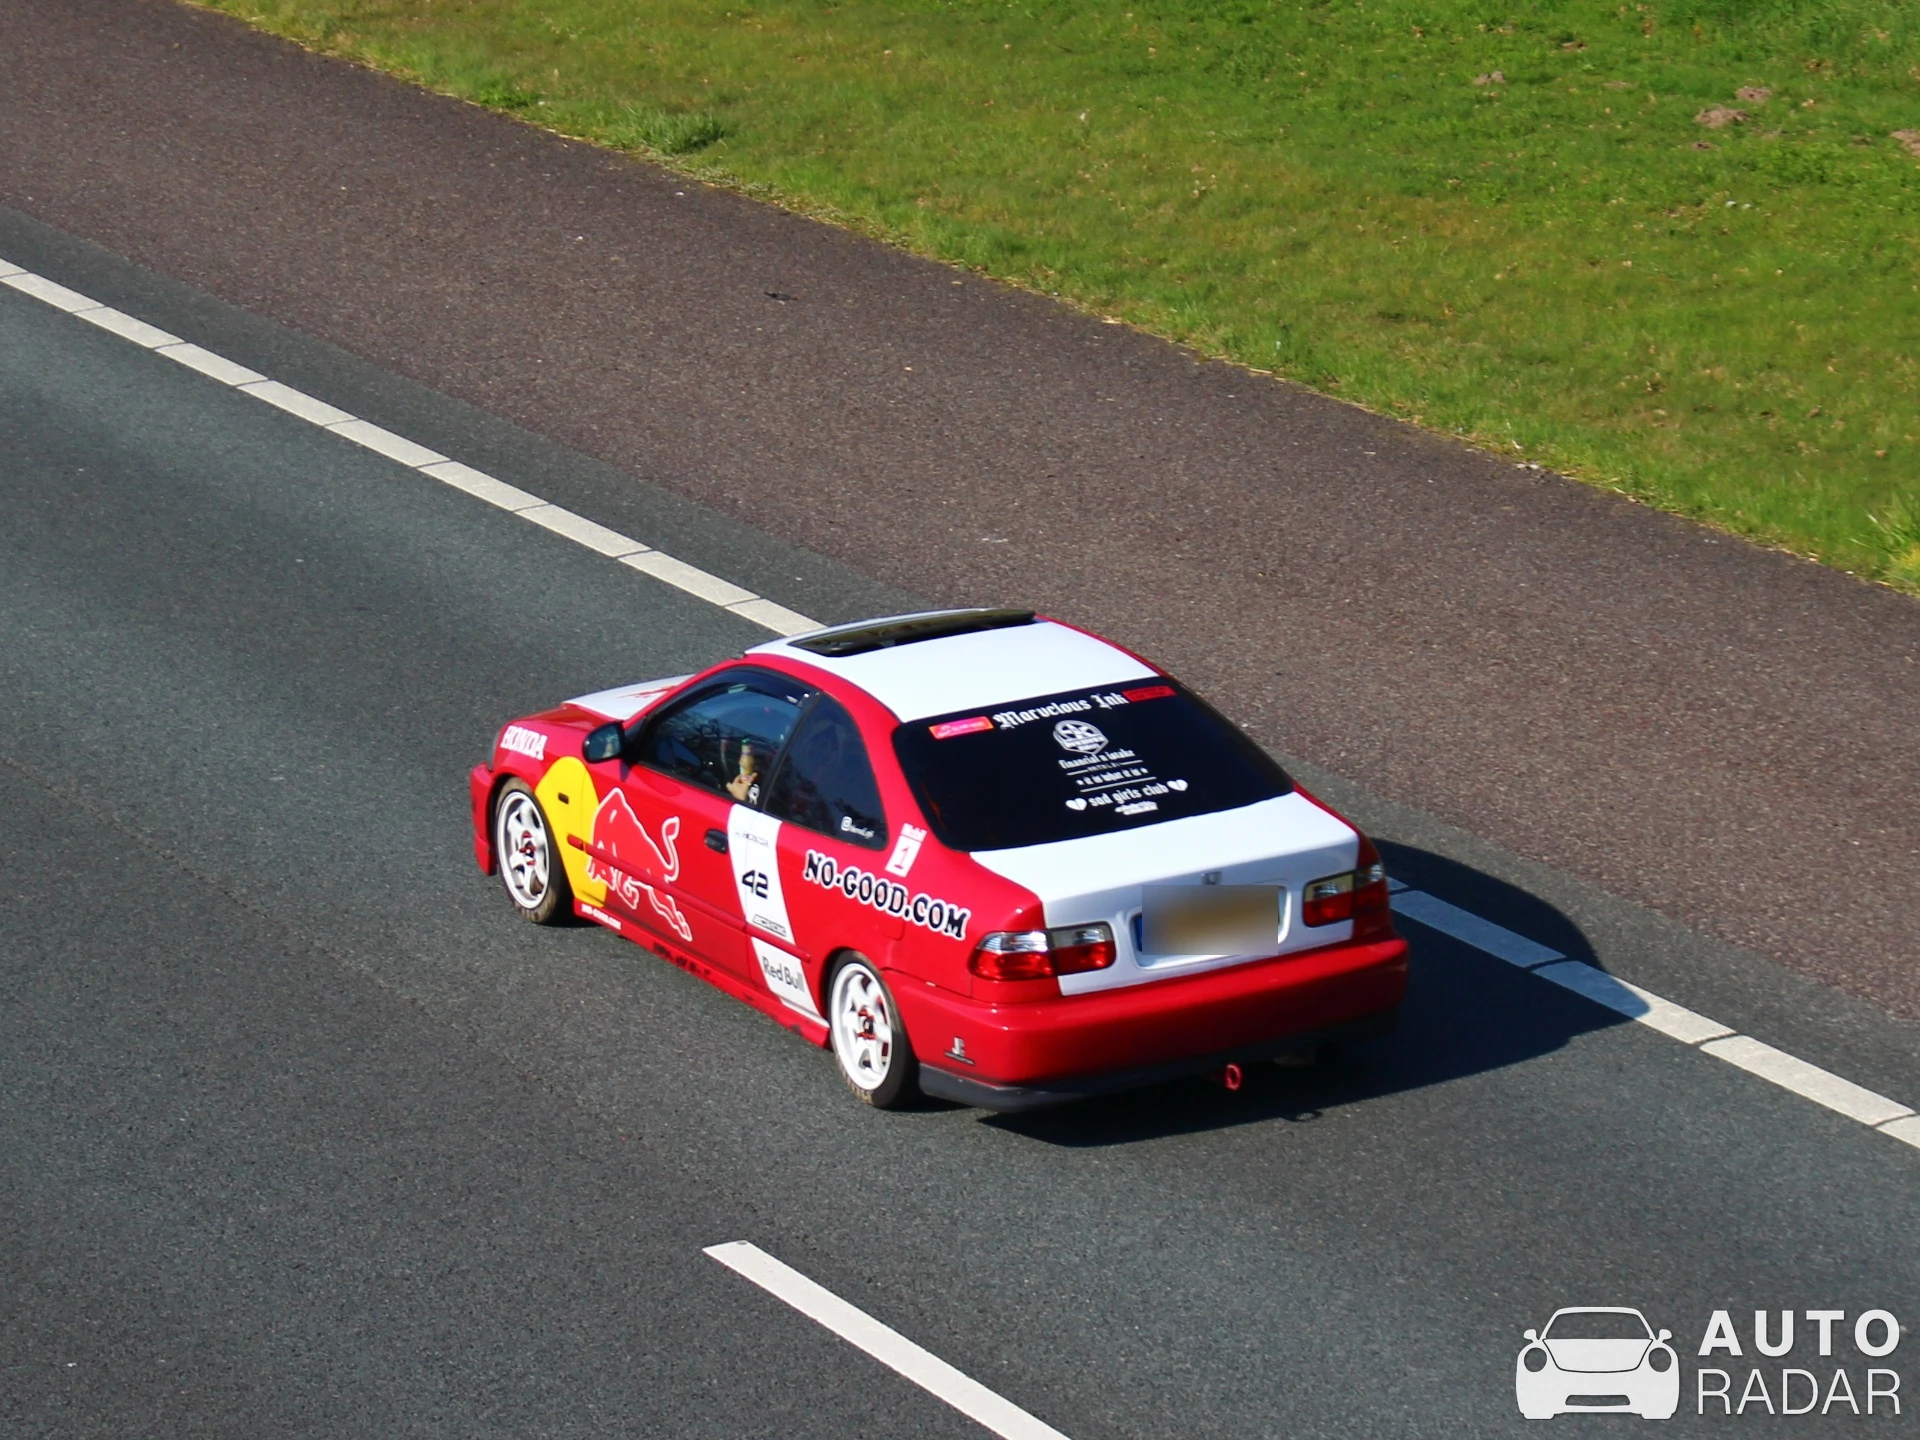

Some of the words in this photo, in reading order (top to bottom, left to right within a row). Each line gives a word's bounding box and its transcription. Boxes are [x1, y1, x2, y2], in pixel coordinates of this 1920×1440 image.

[500, 725, 548, 760] HONDA
[1088, 792, 1113, 807] sad
[1112, 788, 1142, 805] girls
[1141, 783, 1169, 796] club
[742, 869, 769, 900] 42
[762, 955, 784, 981] Red
[783, 965, 806, 993] Bull
